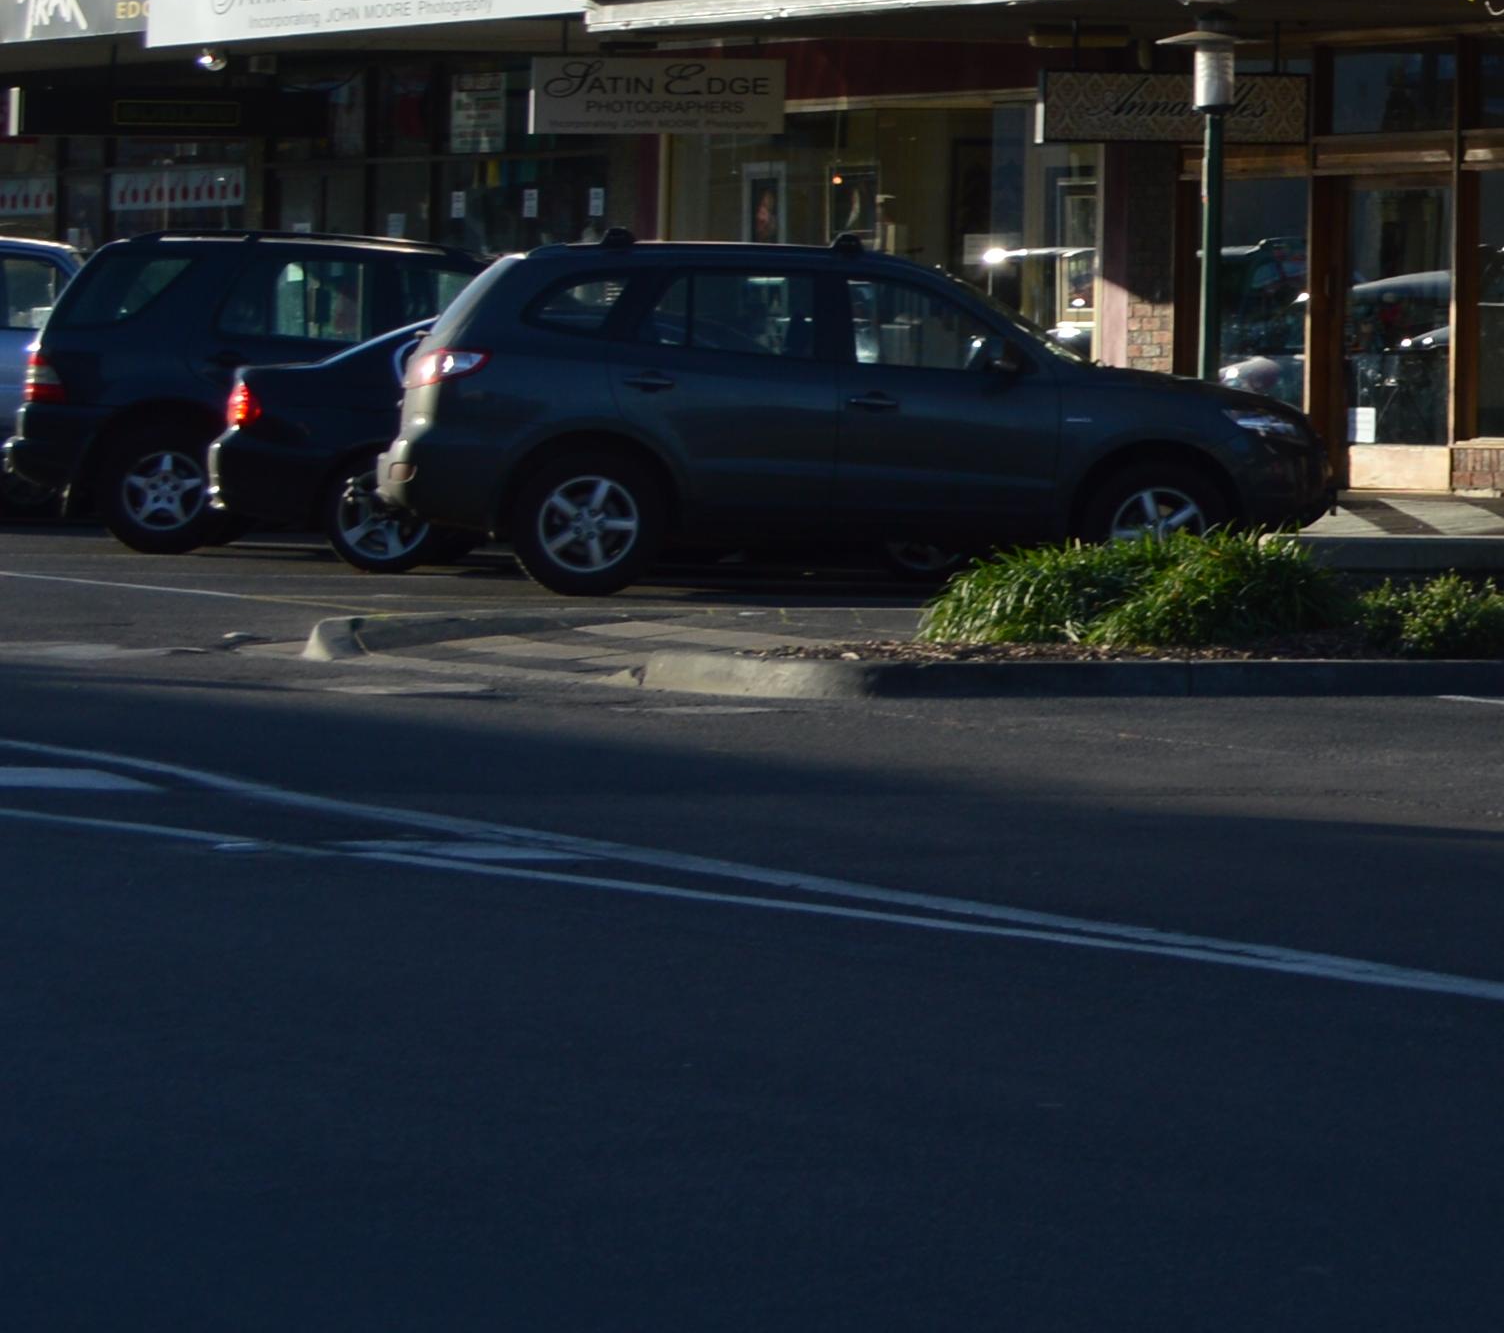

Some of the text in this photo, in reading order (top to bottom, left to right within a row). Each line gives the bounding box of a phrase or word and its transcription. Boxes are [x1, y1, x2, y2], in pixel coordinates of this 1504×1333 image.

[325, 6, 360, 24] JOHN
[364, 1, 412, 20] MOORE
[543, 60, 769, 98] SATIN EDGE
[585, 100, 745, 115] PHOTOGRAPHERS
